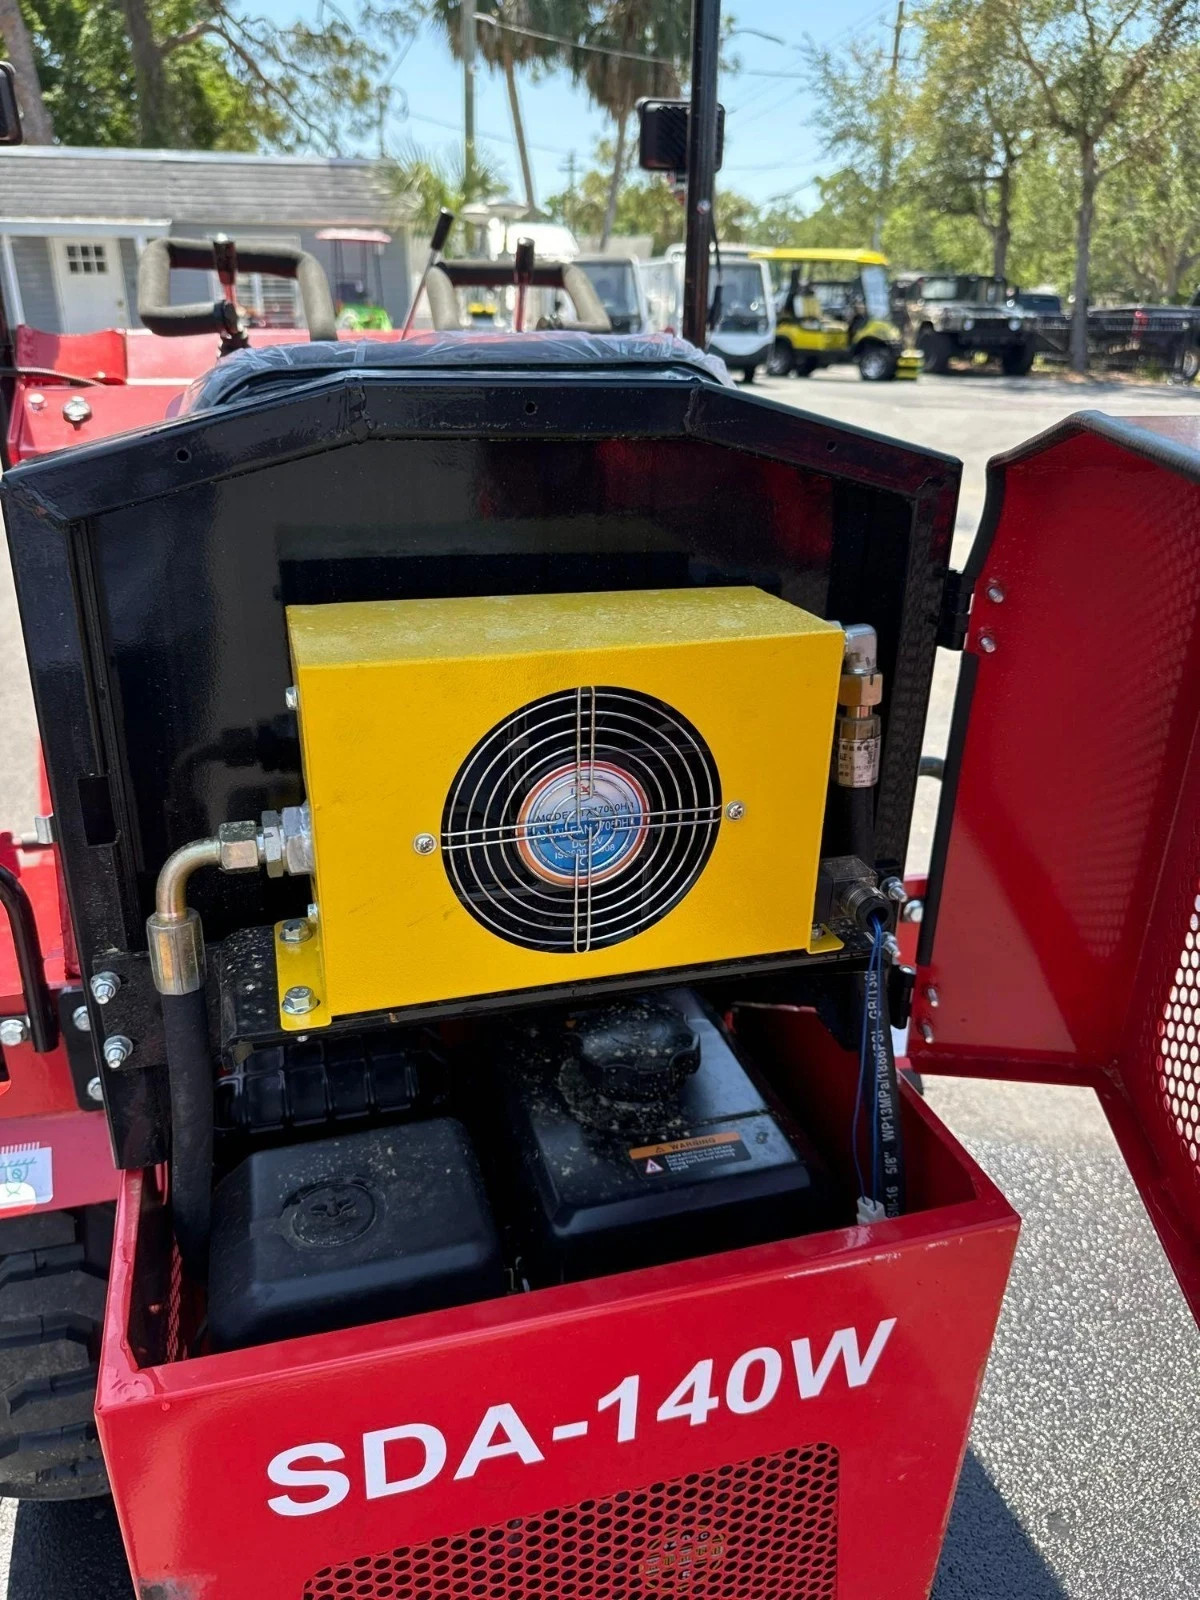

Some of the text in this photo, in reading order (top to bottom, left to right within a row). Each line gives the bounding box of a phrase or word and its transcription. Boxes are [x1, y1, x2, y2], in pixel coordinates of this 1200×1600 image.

[570, 823, 591, 836] FAN
[670, 1137, 717, 1150] WARNING
[266, 1317, 899, 1517] SDA-140W
